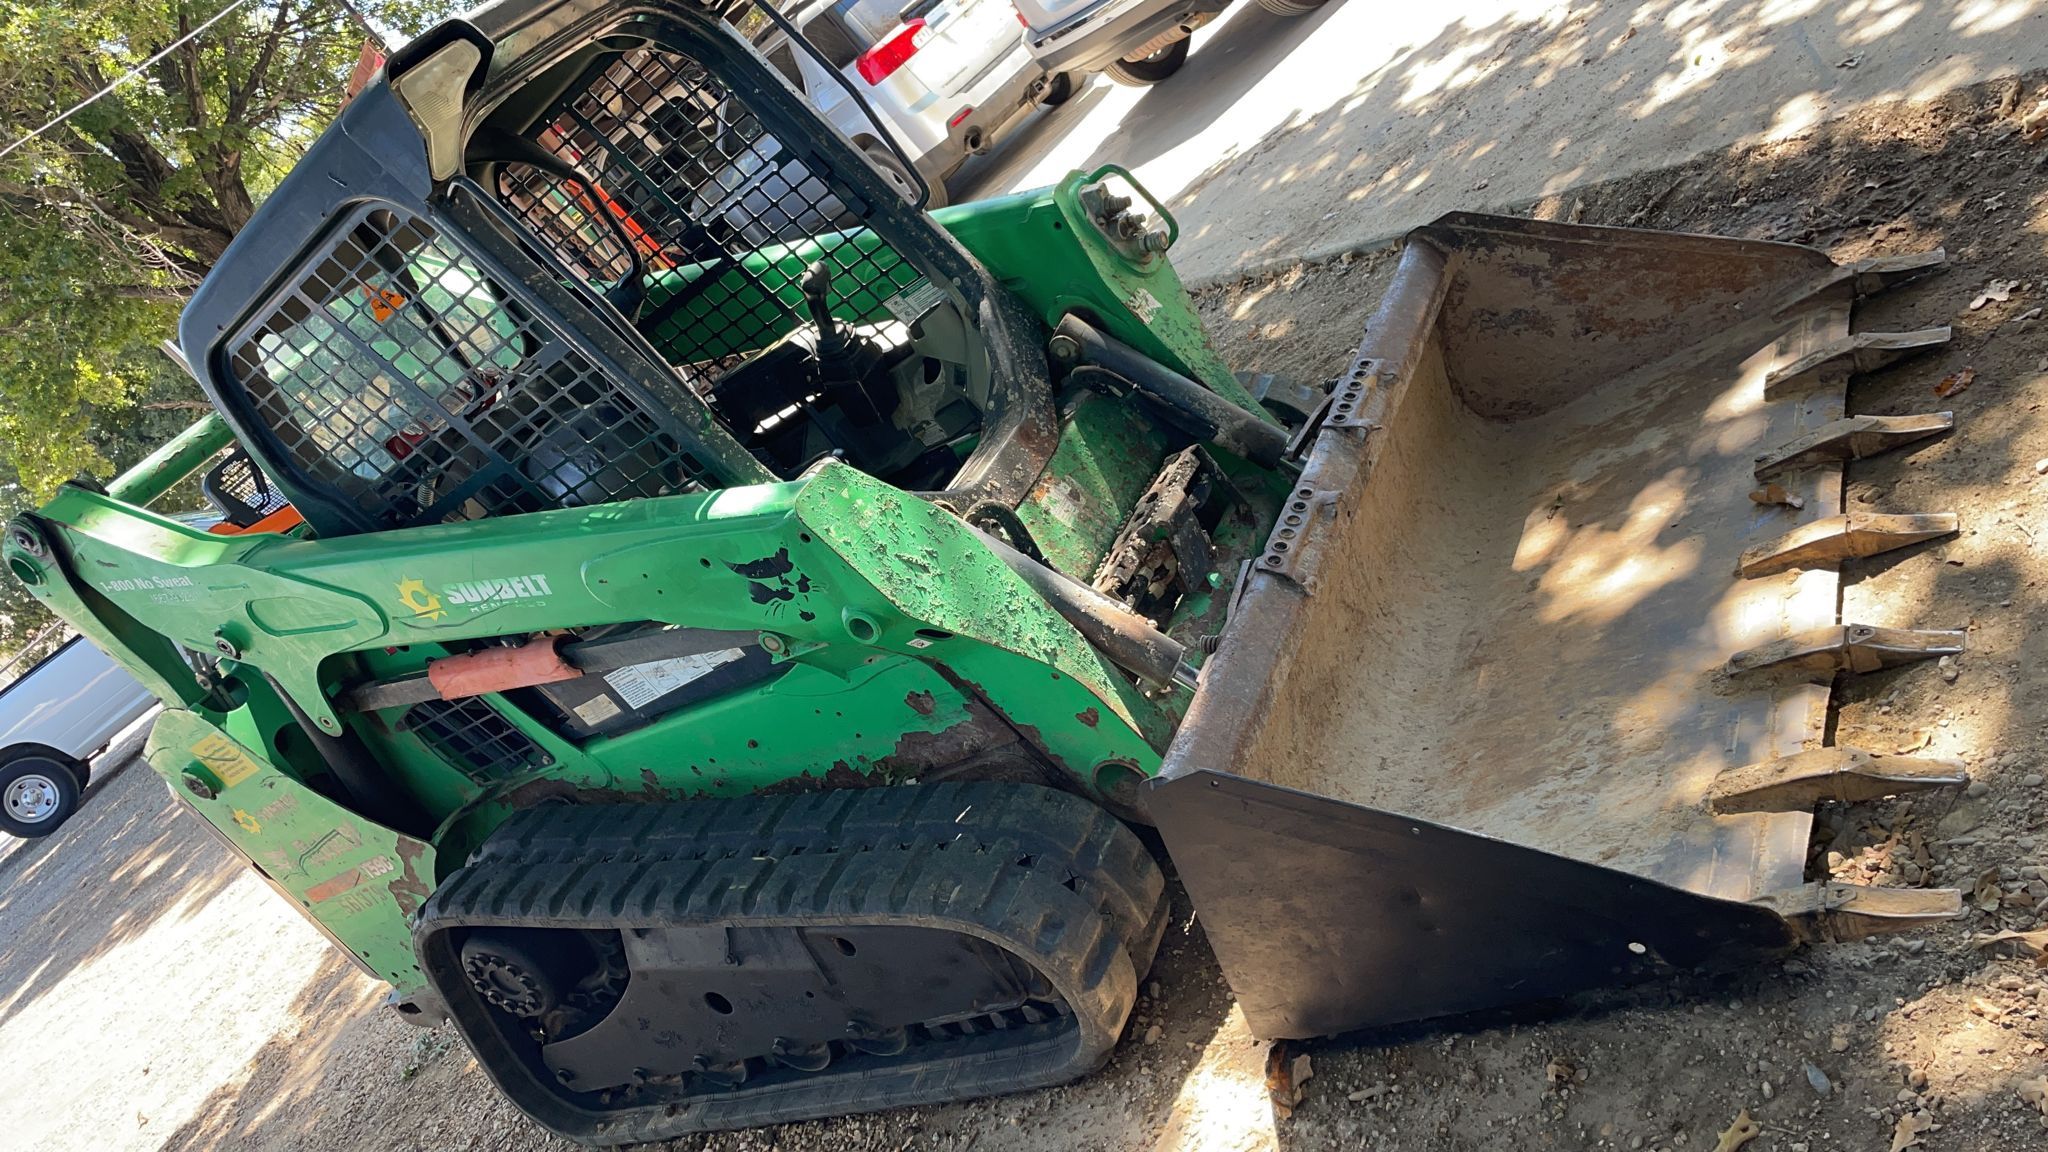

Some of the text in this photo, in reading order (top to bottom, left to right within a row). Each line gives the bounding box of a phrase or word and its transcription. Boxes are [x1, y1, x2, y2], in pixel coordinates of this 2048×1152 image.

[99, 575, 194, 593] 1-800 No Sweat
[441, 574, 553, 604] SUNBELT
